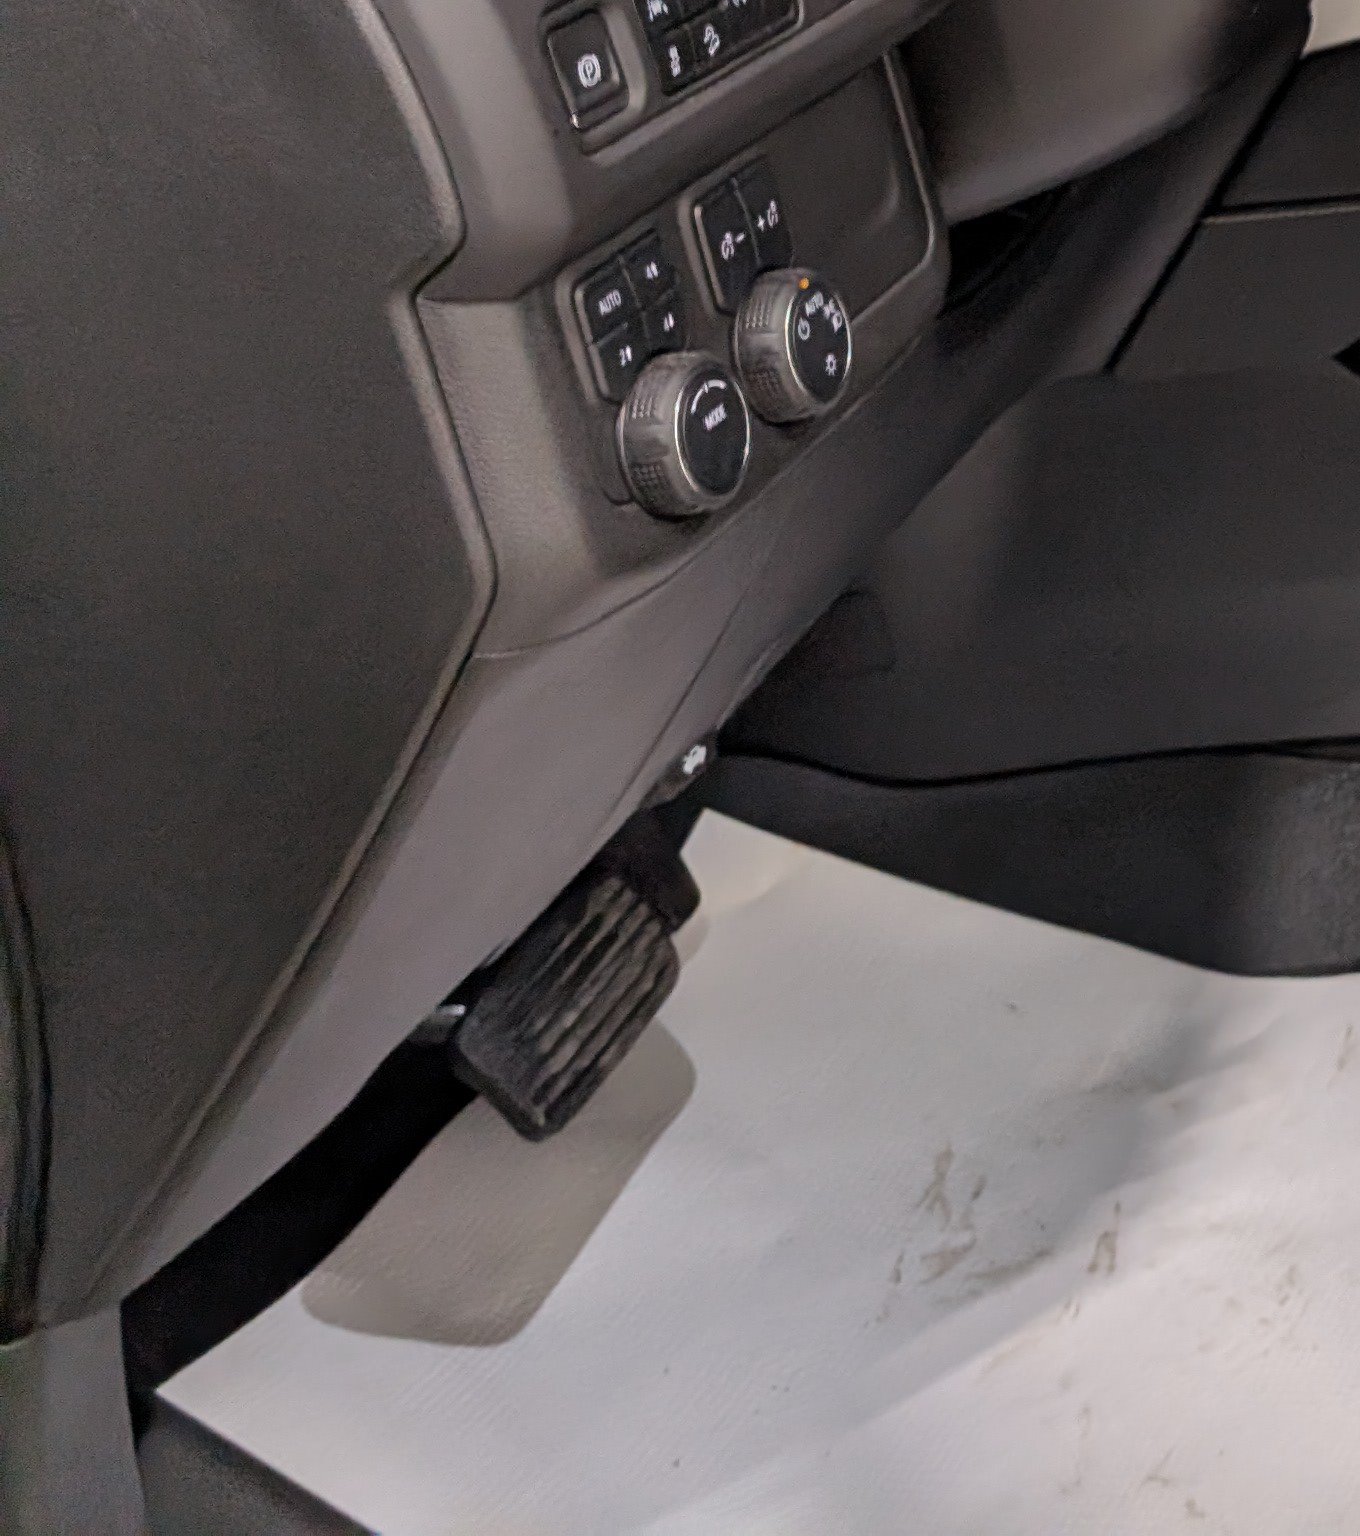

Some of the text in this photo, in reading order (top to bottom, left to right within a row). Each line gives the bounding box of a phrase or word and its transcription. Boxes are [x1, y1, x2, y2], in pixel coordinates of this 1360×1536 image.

[598, 289, 622, 316] AUTO
[805, 291, 824, 317] AUTO
[704, 403, 727, 431] MODE
